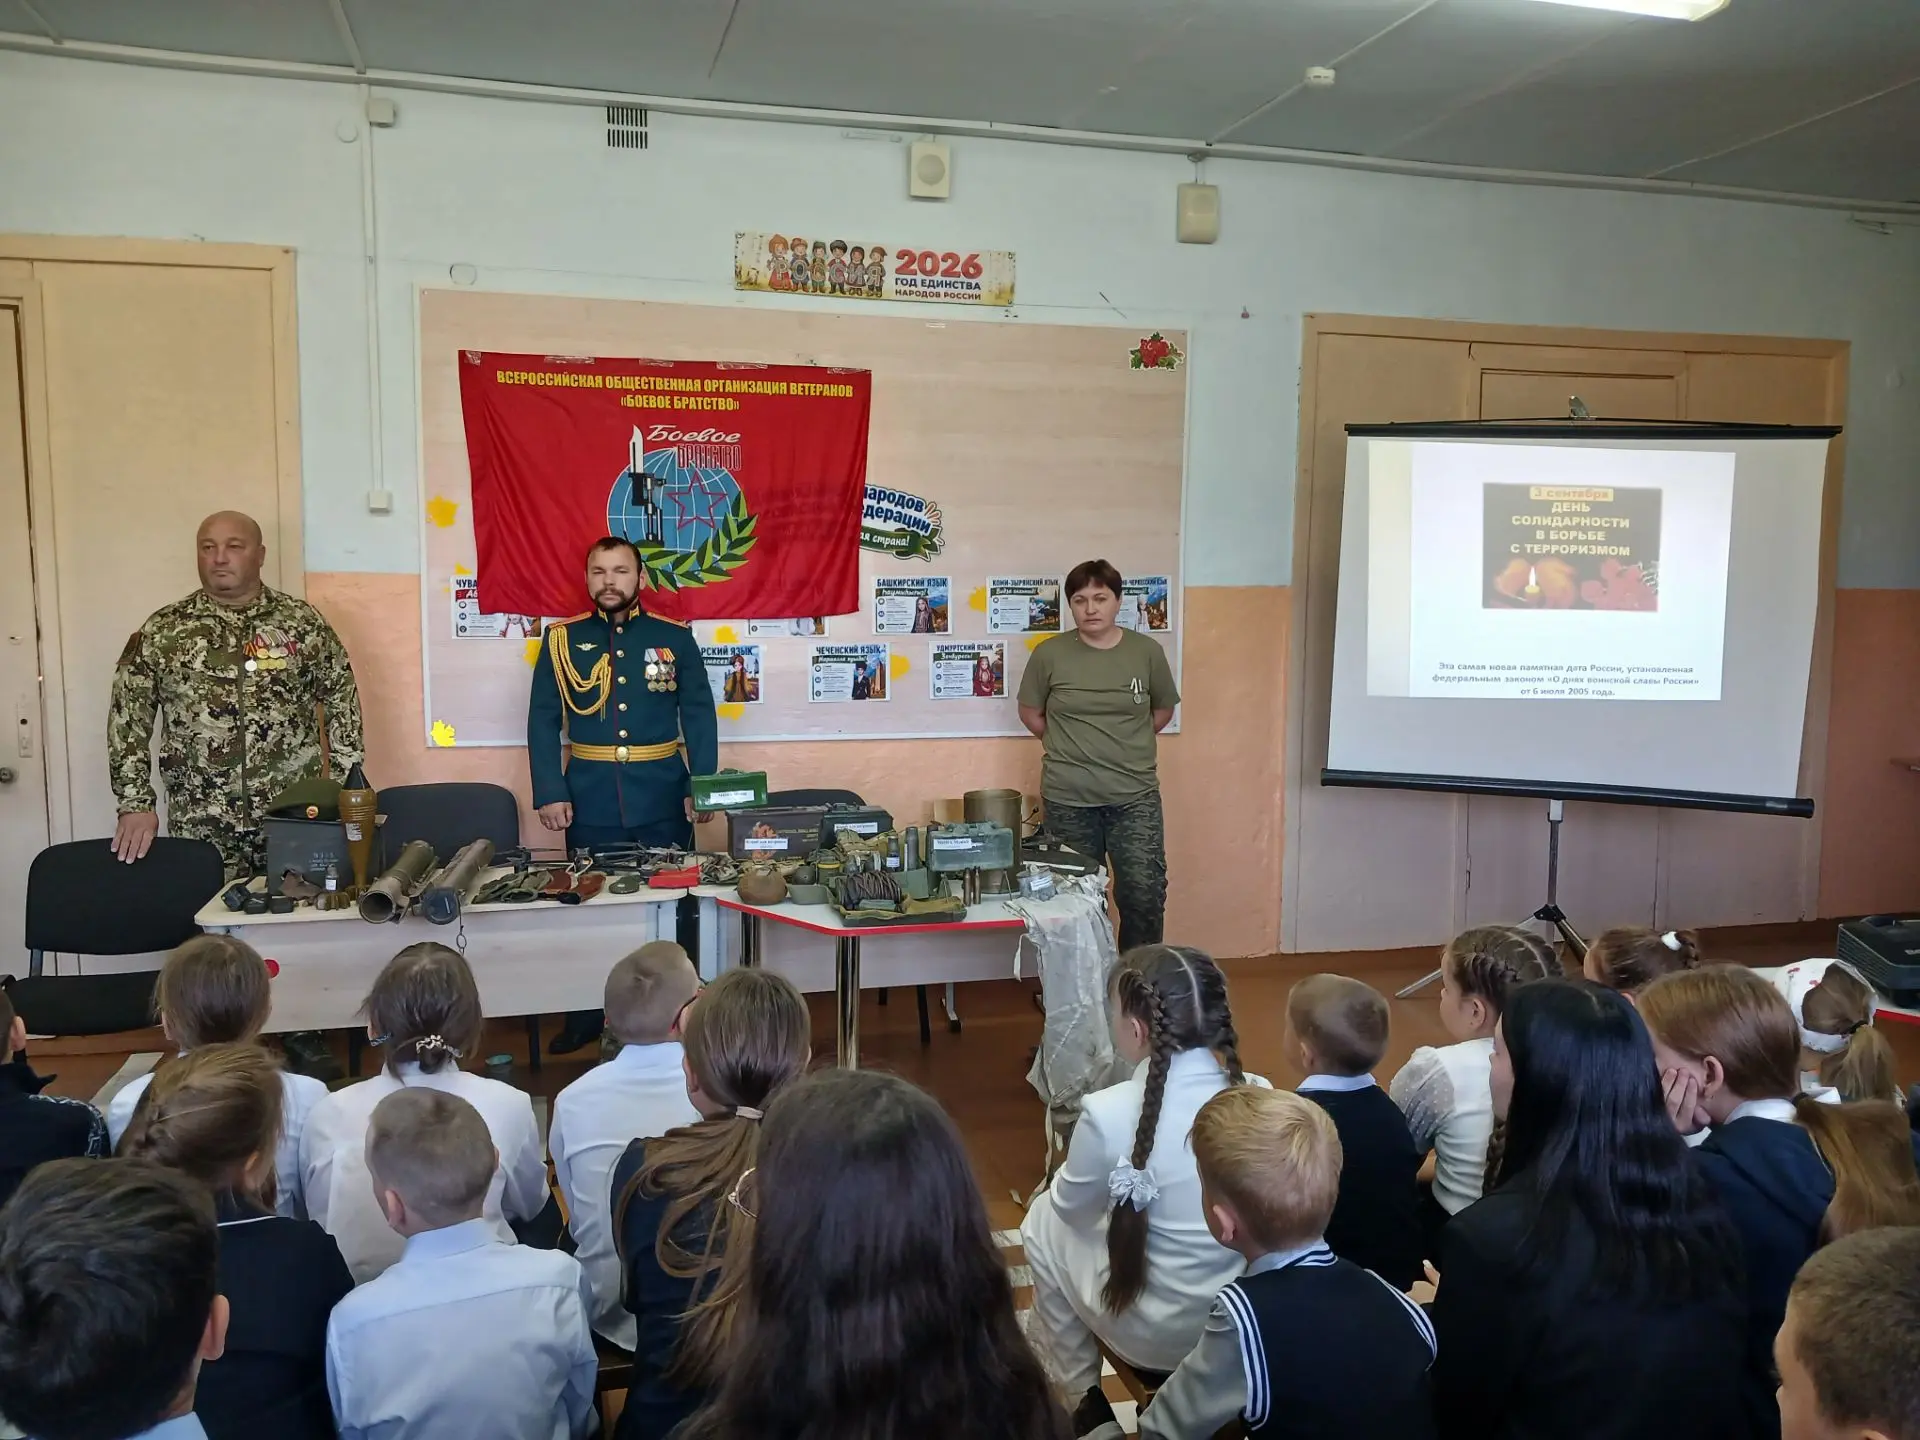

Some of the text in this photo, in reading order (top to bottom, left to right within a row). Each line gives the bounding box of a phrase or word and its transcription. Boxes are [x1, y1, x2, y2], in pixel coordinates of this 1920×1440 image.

[895, 248, 984, 280] 2026
[895, 277, 982, 290] ГОД ЕДИНСТВА
[895, 289, 981, 301] НАРОДОВ РОССИИ
[496, 370, 853, 398] ВСЕРОССИЙСКАЯ ОБЩЕСТВЕННАЯ ОРГАНИЗАЦИЯ ВЕТЕРАНОВ
[620, 394, 740, 411] «БОЕВОЕ БРАТСТВО»
[646, 424, 741, 443] Боевое
[676, 444, 742, 471] БРАТСТВО
[1534, 487, 1609, 501] 3 сентября
[1551, 501, 1591, 513] ДЕНЬ
[862, 504, 932, 534] дерации
[1511, 515, 1631, 529] СОЛИДАРНОСТИ
[872, 535, 910, 548] страна!
[1535, 530, 1607, 541] В БОРЬБЕ
[1510, 543, 1631, 556] С ТЕРРОРИЗМОМ
[877, 577, 948, 588] БАШКИРСКИЙ ЯЗЫК
[730, 646, 753, 656] ЯЗЫК
[816, 644, 859, 655] ЧЕЧЕНСКИЙ
[860, 645, 881, 654] ЯЗЫК
[1439, 662, 1694, 675] Эта самая новая памятная дата России, установленная
[1432, 673, 1699, 685] федеральным законом «О днях воинской славы России»
[1532, 686, 1539, 695] 6
[1540, 687, 1565, 696] июля
[1568, 687, 1589, 696] 2005
[1591, 688, 1616, 697] года.
